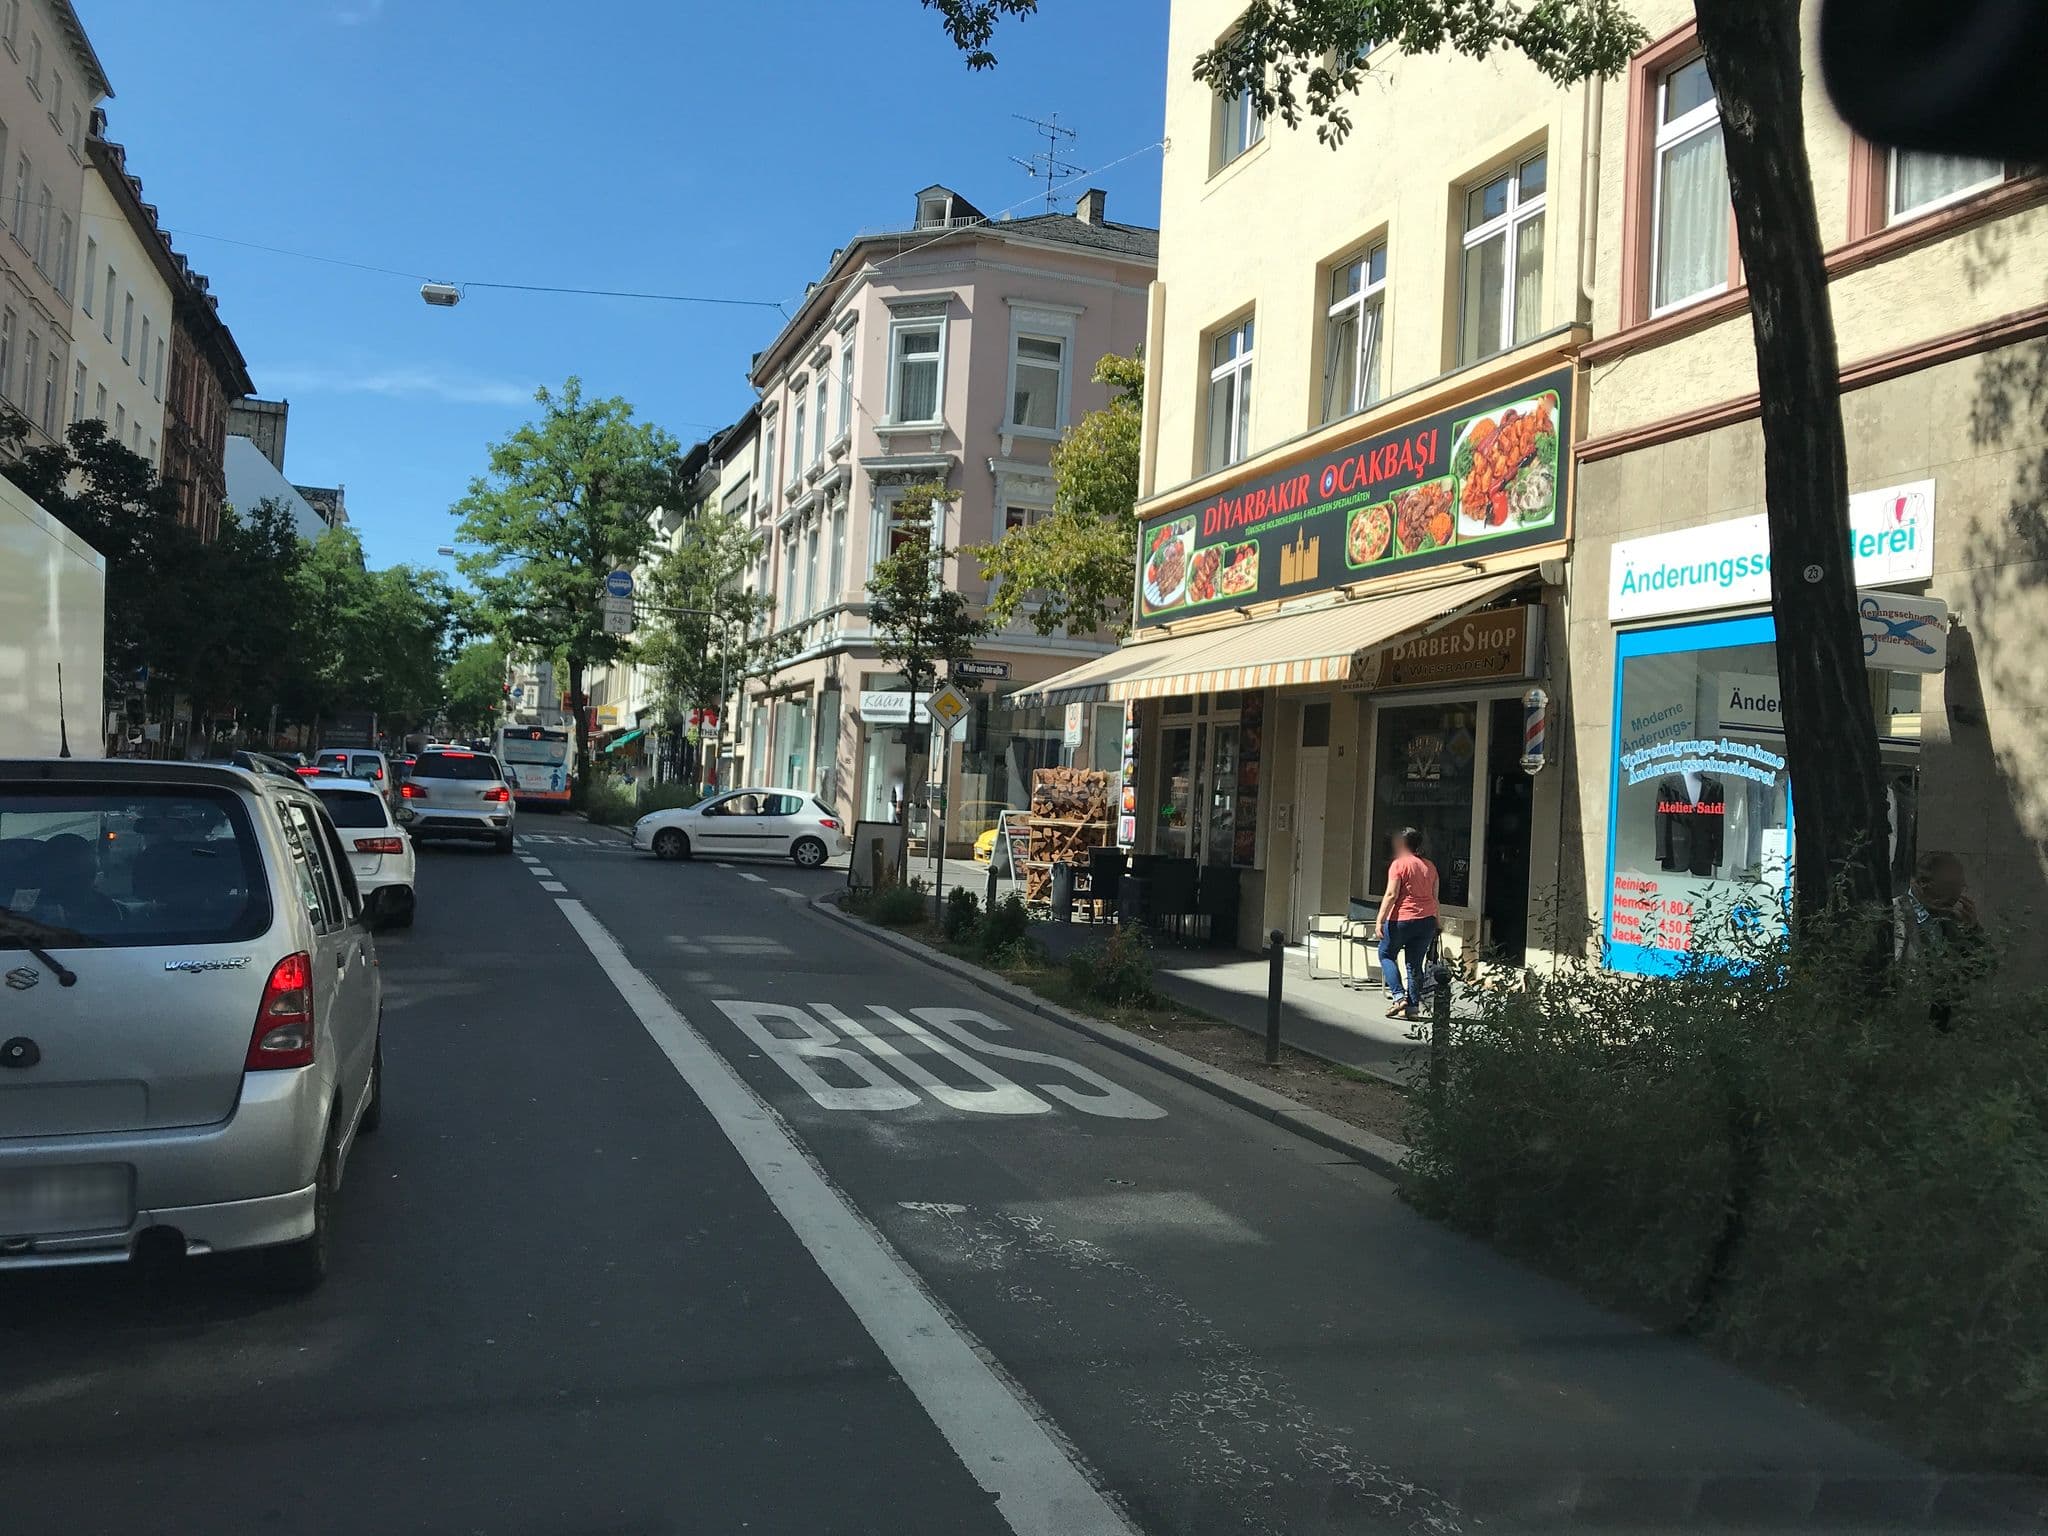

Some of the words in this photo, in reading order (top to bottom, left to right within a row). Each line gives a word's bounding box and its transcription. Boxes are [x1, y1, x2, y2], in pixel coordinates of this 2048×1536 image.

[1203, 473, 1311, 536] DİYARBAKIR
[1319, 428, 1438, 498] OCAKBAŞI
[1333, 491, 1371, 511] SPEZIALITÄTEN
[1807, 568, 1819, 579] 23
[1861, 609, 1947, 633] derungsschneiderei
[1409, 656, 1495, 677] WIESBADEN
[1730, 687, 1782, 713] Änder
[1631, 703, 1684, 732] Moderne
[531, 731, 541, 741] 17
[1623, 720, 1692, 753] Änderungs-
[1620, 738, 1786, 770] Vollreinigungs-Annahme
[1628, 757, 1777, 786] Änderungsschneiderei
[1658, 801, 1694, 813] Atelier
[1696, 802, 1726, 815] Saidi
[1661, 899, 1683, 915] 1,80
[1612, 910, 1640, 927] Hose
[1612, 927, 1643, 945] Jacke
[711, 999, 1169, 1120] BUS
